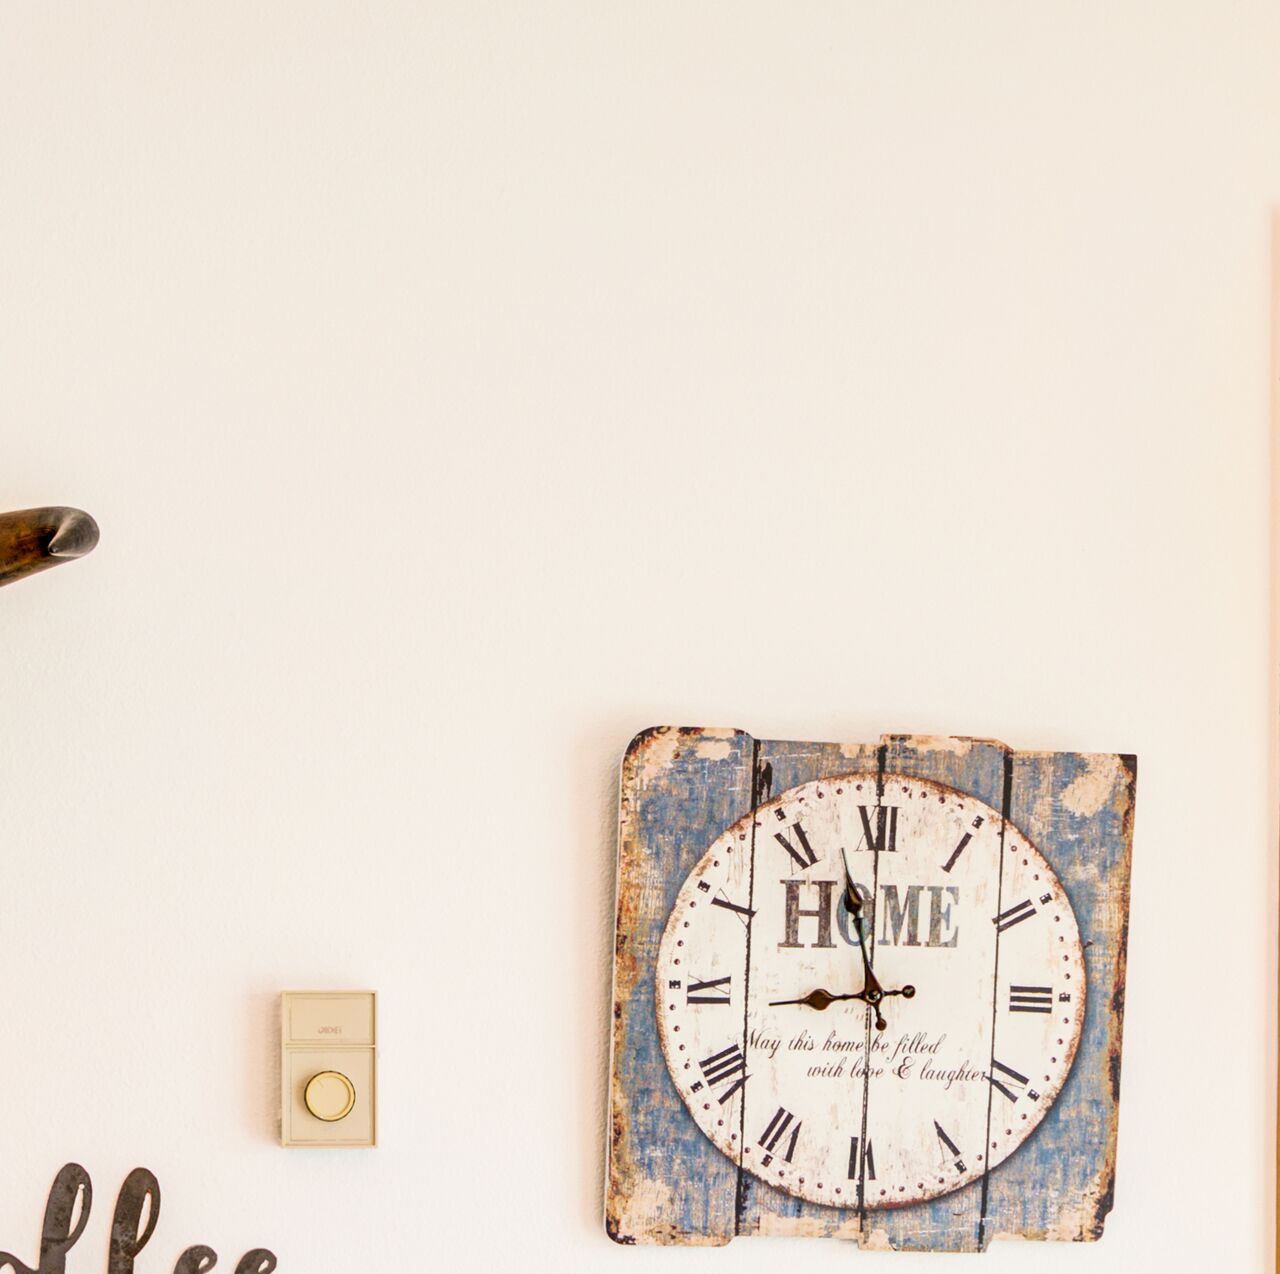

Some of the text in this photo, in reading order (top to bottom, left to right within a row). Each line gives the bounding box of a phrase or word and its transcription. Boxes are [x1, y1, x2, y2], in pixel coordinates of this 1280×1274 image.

[854, 805, 901, 852] XII
[941, 832, 973, 873] I
[777, 879, 959, 949] HOME
[992, 898, 1038, 933] II
[1009, 984, 1053, 1014] III
[745, 1028, 947, 1062] May this home be filled
[807, 1056, 987, 1090] with love & laughter
